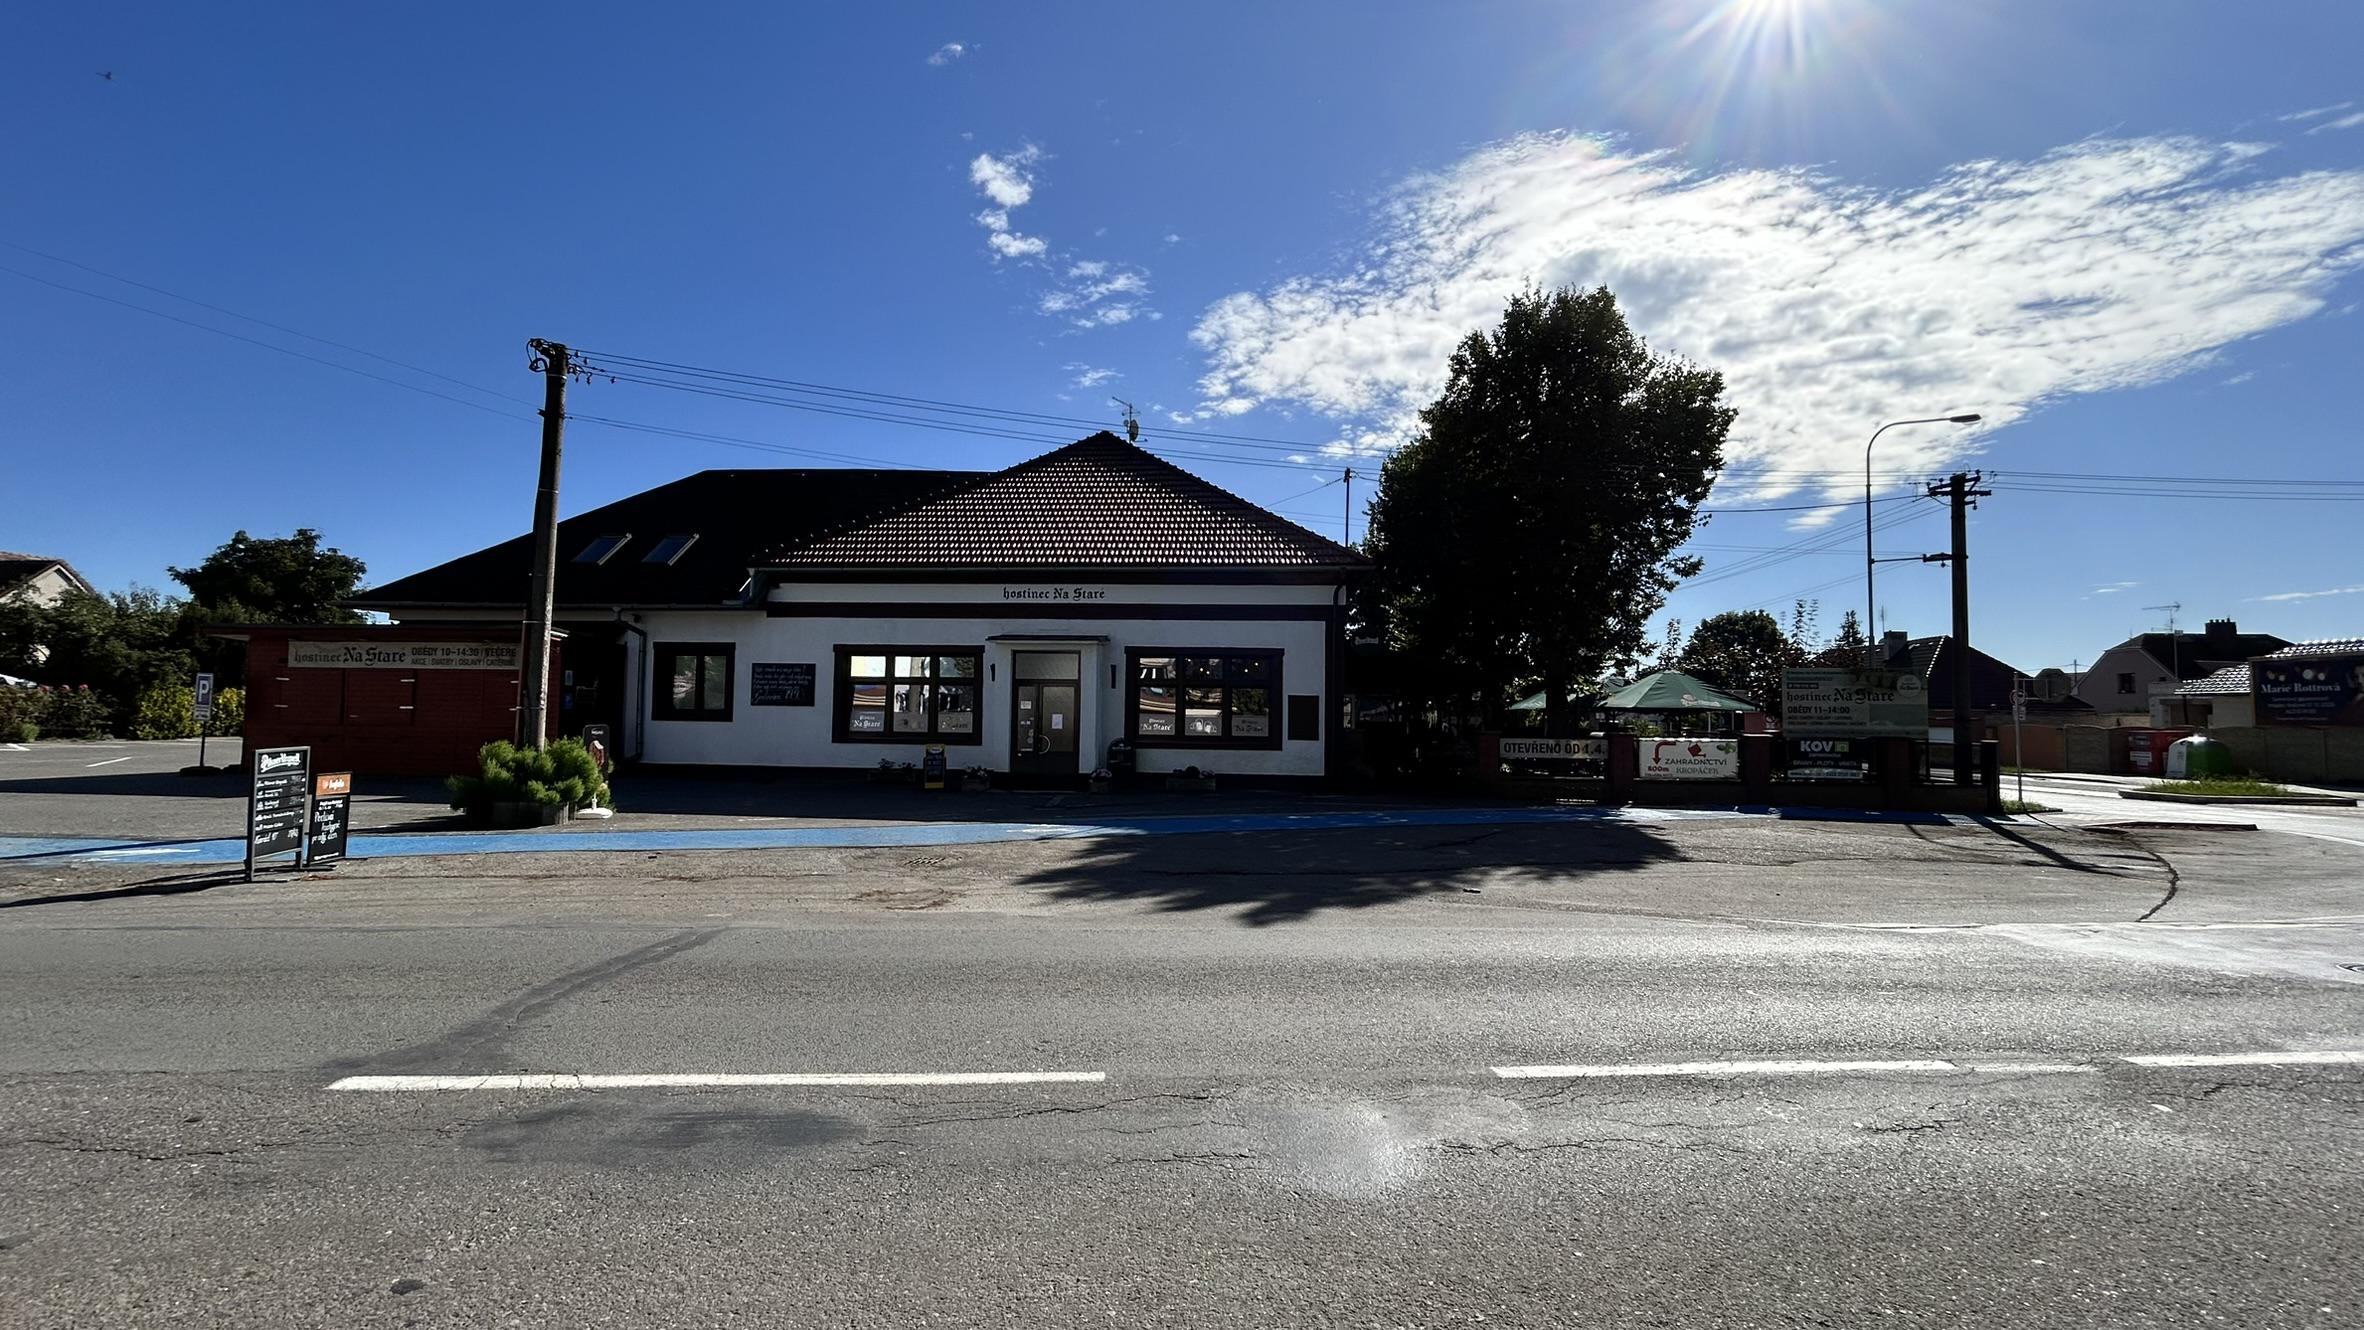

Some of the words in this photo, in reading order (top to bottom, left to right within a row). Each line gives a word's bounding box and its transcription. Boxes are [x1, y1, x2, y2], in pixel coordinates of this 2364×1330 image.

[1003, 587, 1050, 600] hostinec
[1053, 588, 1069, 600] Na
[1073, 588, 1105, 602] Staré
[294, 648, 341, 663] hostinec
[343, 647, 362, 663] Na
[365, 647, 406, 666] Staré
[2260, 683, 2291, 693] Marie
[1787, 691, 1832, 703] hostinec
[1834, 688, 1853, 702] Na
[1855, 688, 1895, 704] Staré
[1504, 741, 1561, 754] OTEVŘENO
[1565, 743, 1580, 754] OD
[1665, 758, 1727, 766] ZAHRADNICTVÍ
